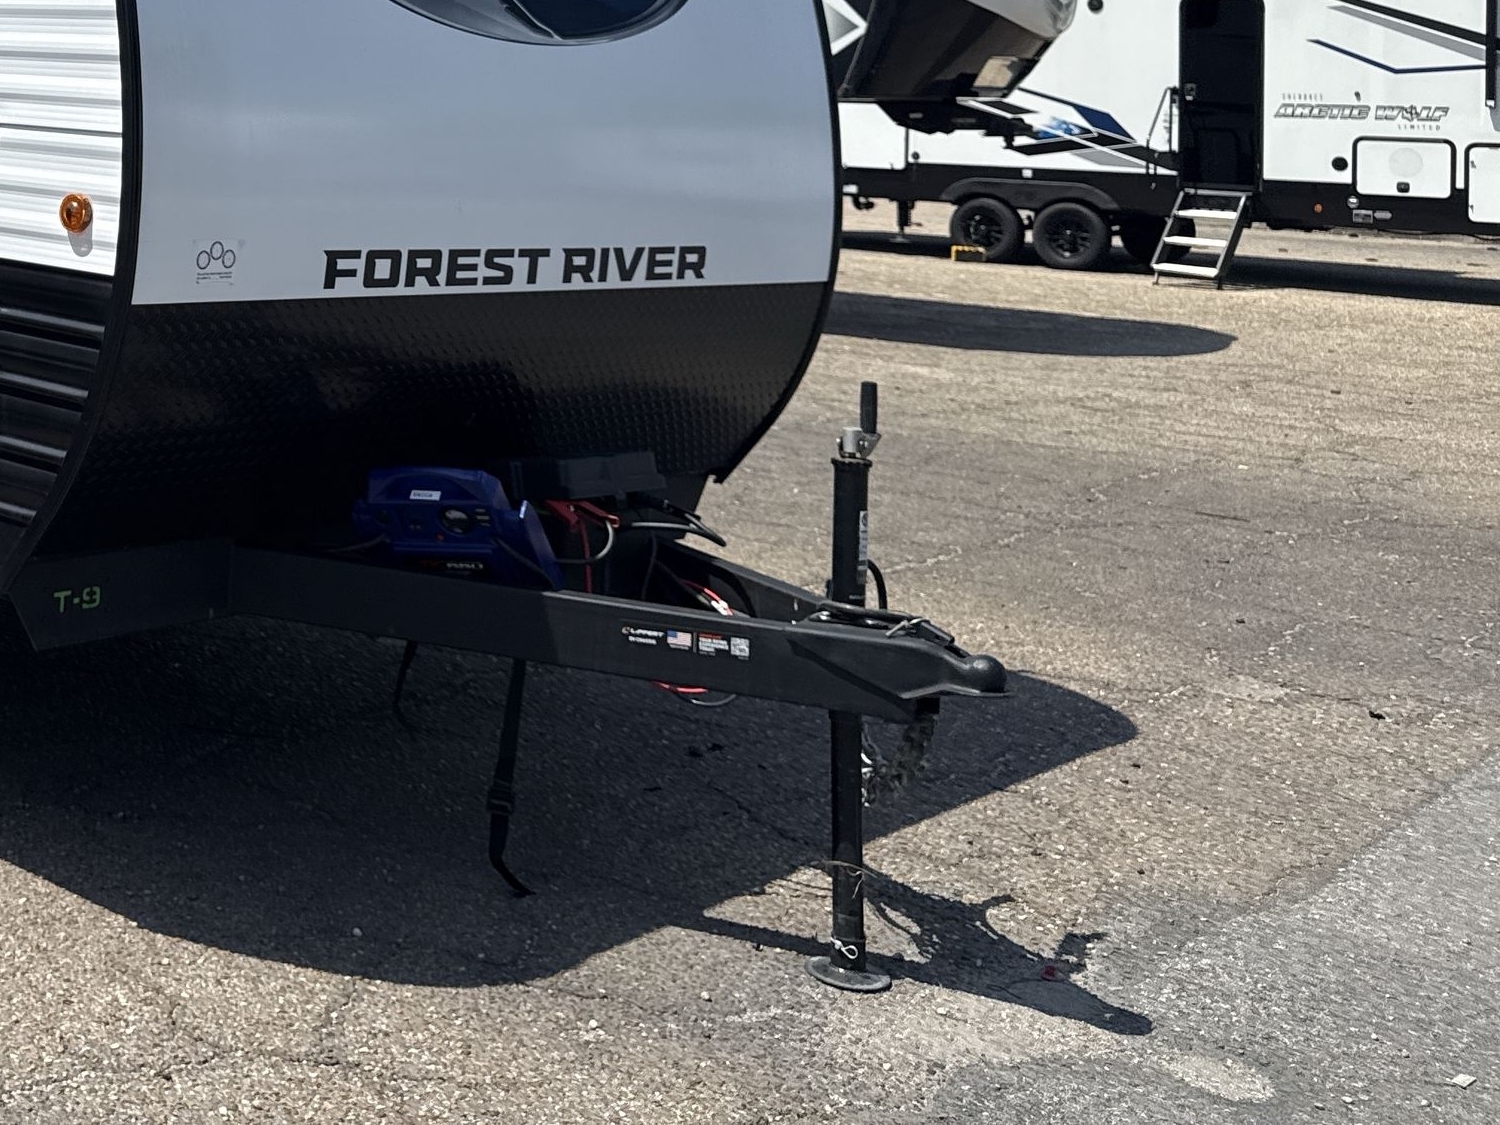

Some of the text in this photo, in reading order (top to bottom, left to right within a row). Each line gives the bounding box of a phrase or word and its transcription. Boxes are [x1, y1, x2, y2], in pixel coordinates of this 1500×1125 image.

[1274, 103, 1371, 119] ARCTIC
[323, 246, 707, 289] FOREST RIVER
